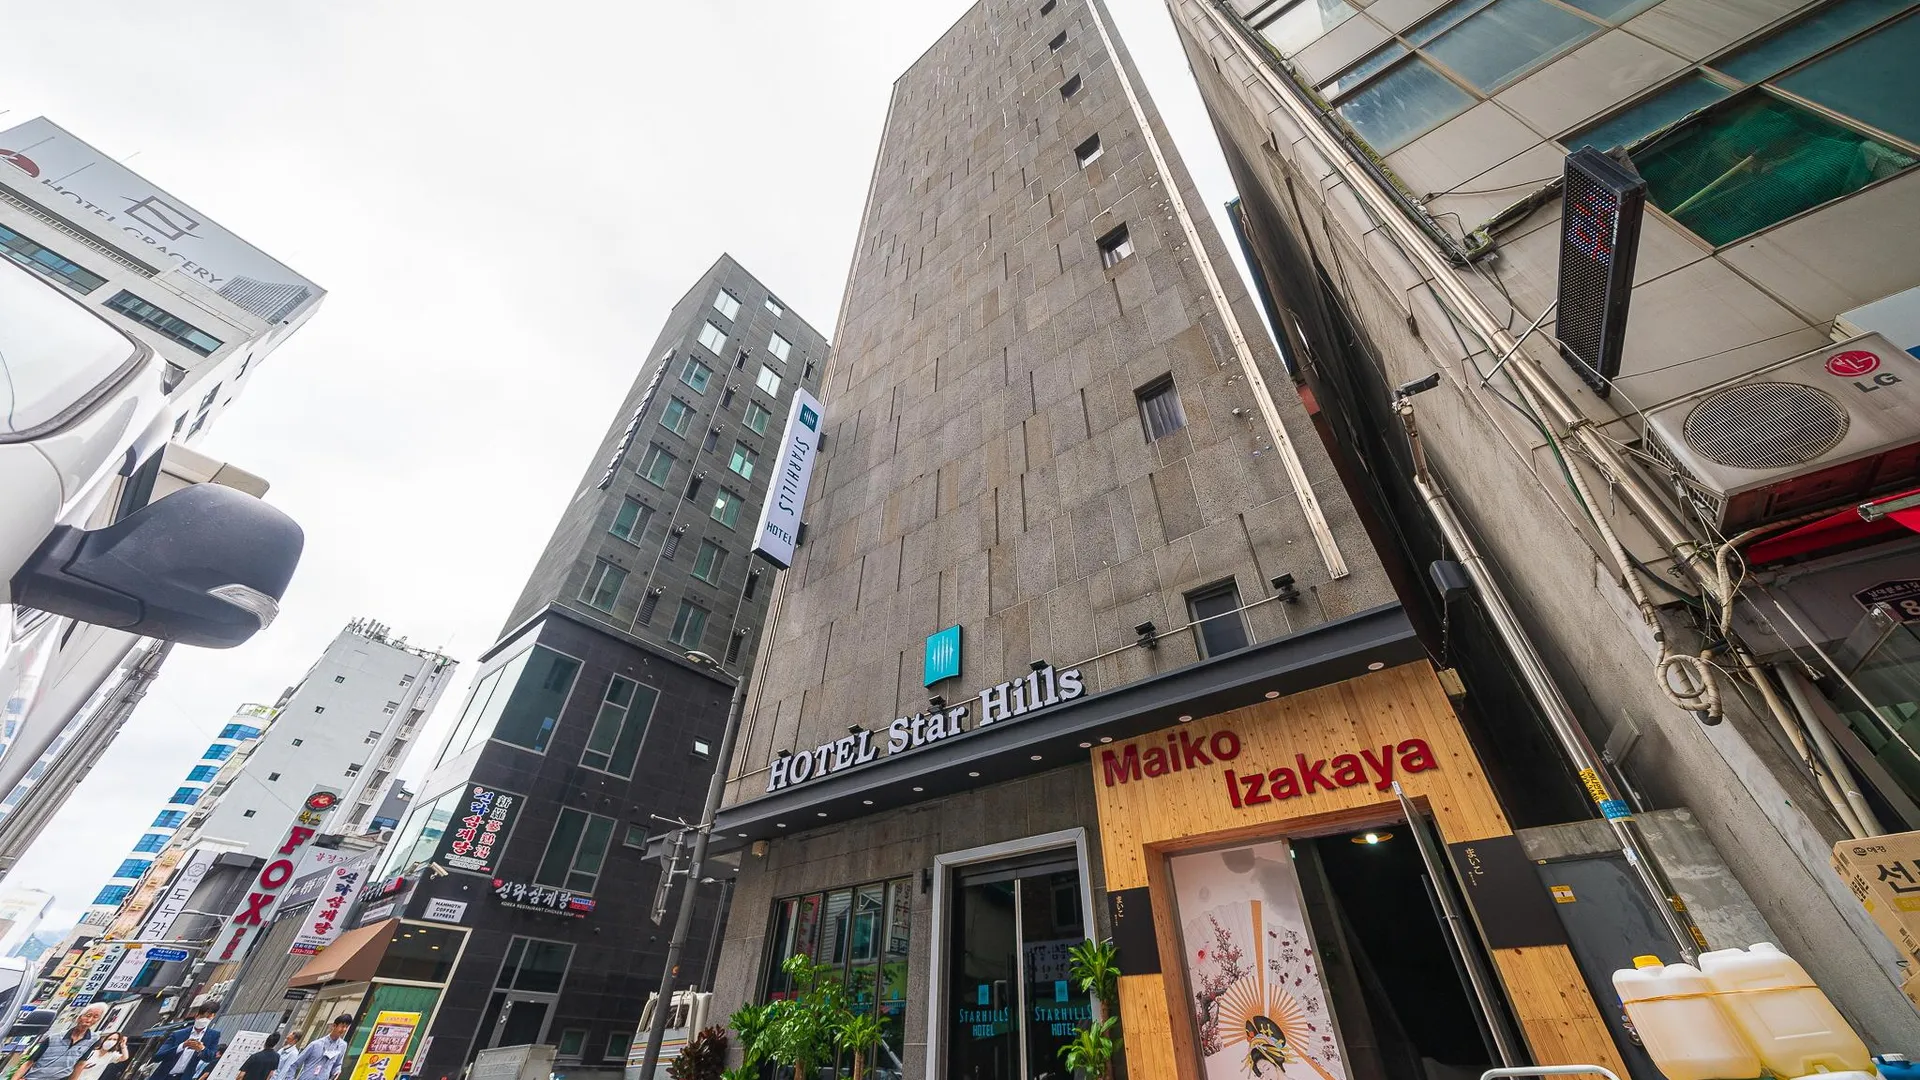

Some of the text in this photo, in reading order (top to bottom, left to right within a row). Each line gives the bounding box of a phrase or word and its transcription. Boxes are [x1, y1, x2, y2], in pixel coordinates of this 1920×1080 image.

[1854, 373, 1902, 393] LG
[779, 436, 810, 516] STARHILLS
[766, 520, 792, 546] HOTEL
[766, 664, 1086, 793] HOTEL Star Hills
[1101, 730, 1241, 788] Maiko
[1223, 737, 1439, 809] Izakaya
[452, 791, 494, 855] 신라삼계탕
[314, 872, 359, 936] 신라삼계탕
[435, 901, 461, 909] MAMMOTH
[496, 881, 572, 910] 신라삼계탕
[960, 1007, 1008, 1023] STARHILLS
[1035, 1003, 1092, 1021] STARHILLS
[972, 1024, 995, 1037] HOTEL
[1051, 1022, 1077, 1036] HOTEL
